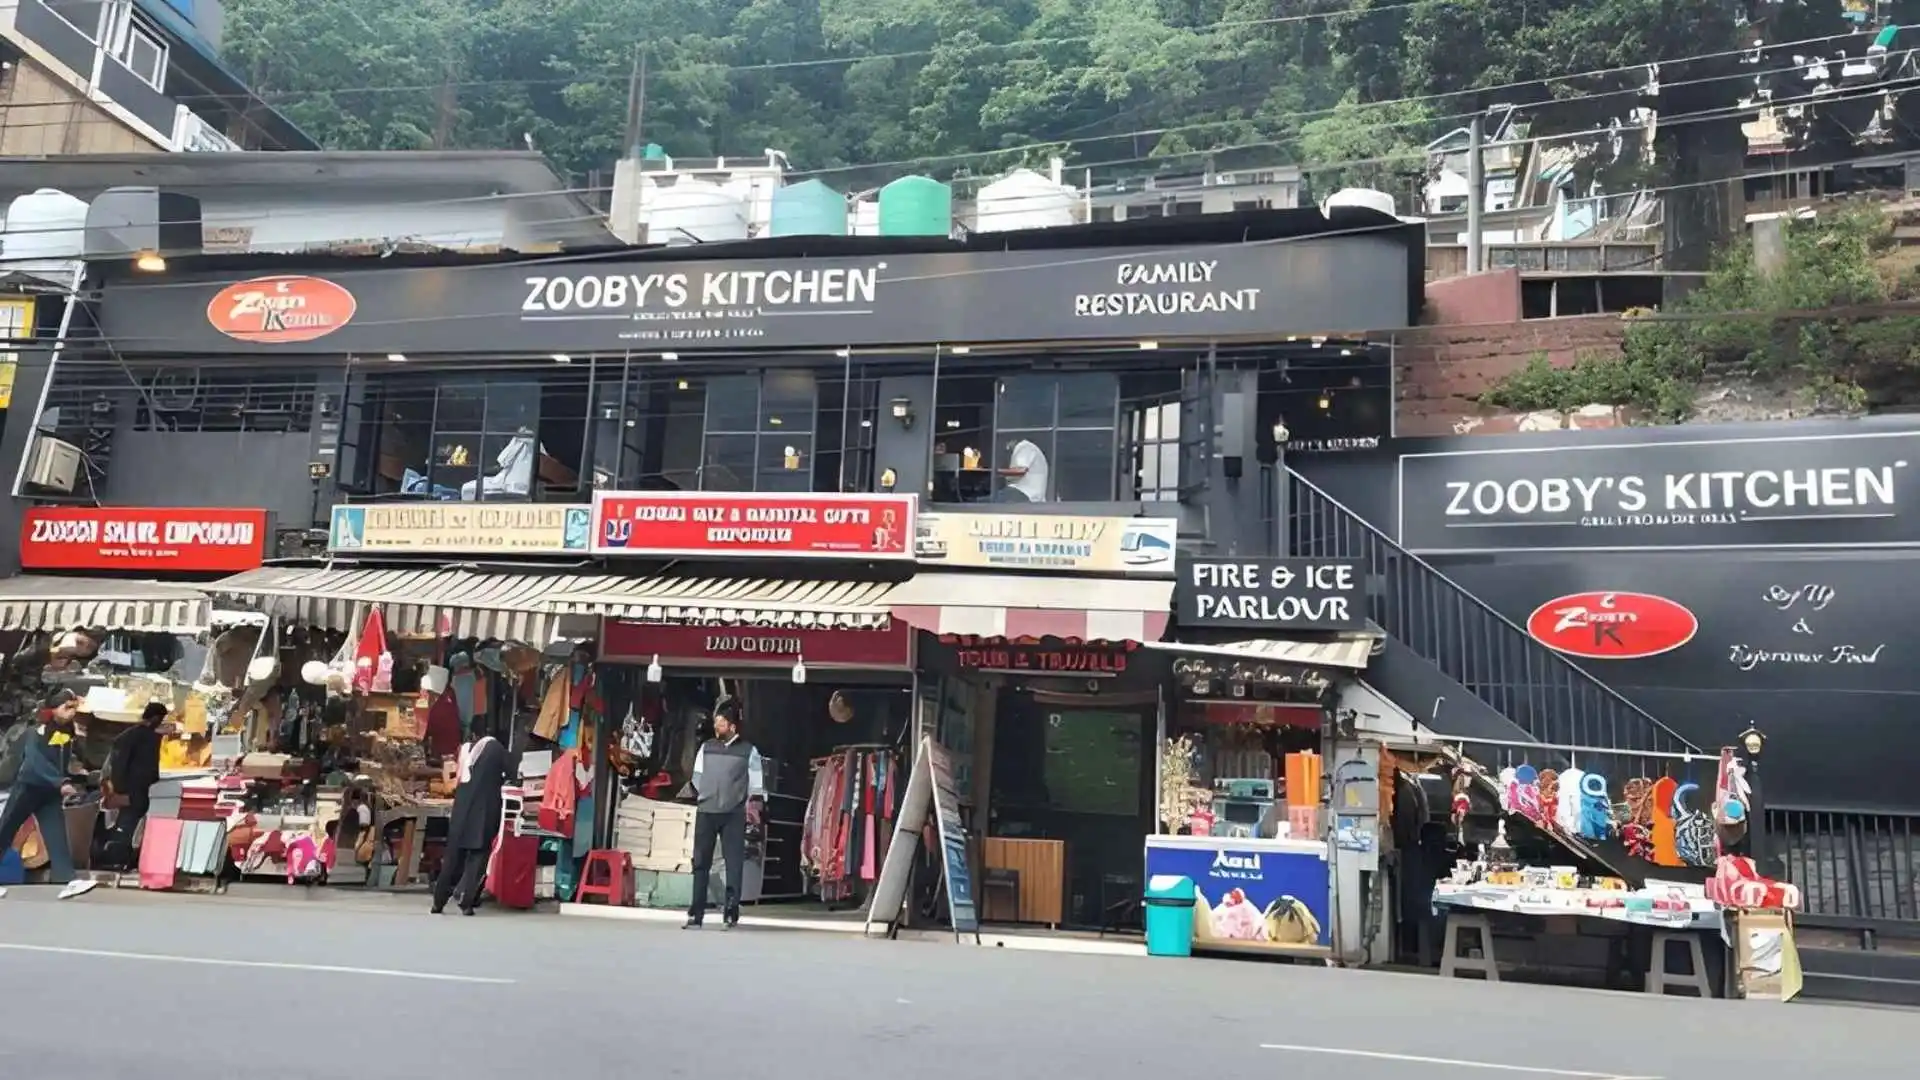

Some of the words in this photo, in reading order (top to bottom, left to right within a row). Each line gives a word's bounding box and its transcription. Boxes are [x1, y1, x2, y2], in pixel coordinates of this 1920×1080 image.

[1117, 260, 1218, 285] FAMILY
[522, 274, 688, 310] ZOOBY'S
[701, 268, 876, 307] KITCHEN
[1074, 288, 1261, 317] RESTAURANT
[1445, 476, 1647, 517] ZOOBY'S
[1664, 466, 1896, 511] KITCHEN
[1193, 563, 1260, 588] FIRE
[1306, 565, 1354, 590] ICE
[1196, 595, 1350, 621] PARLOUR
